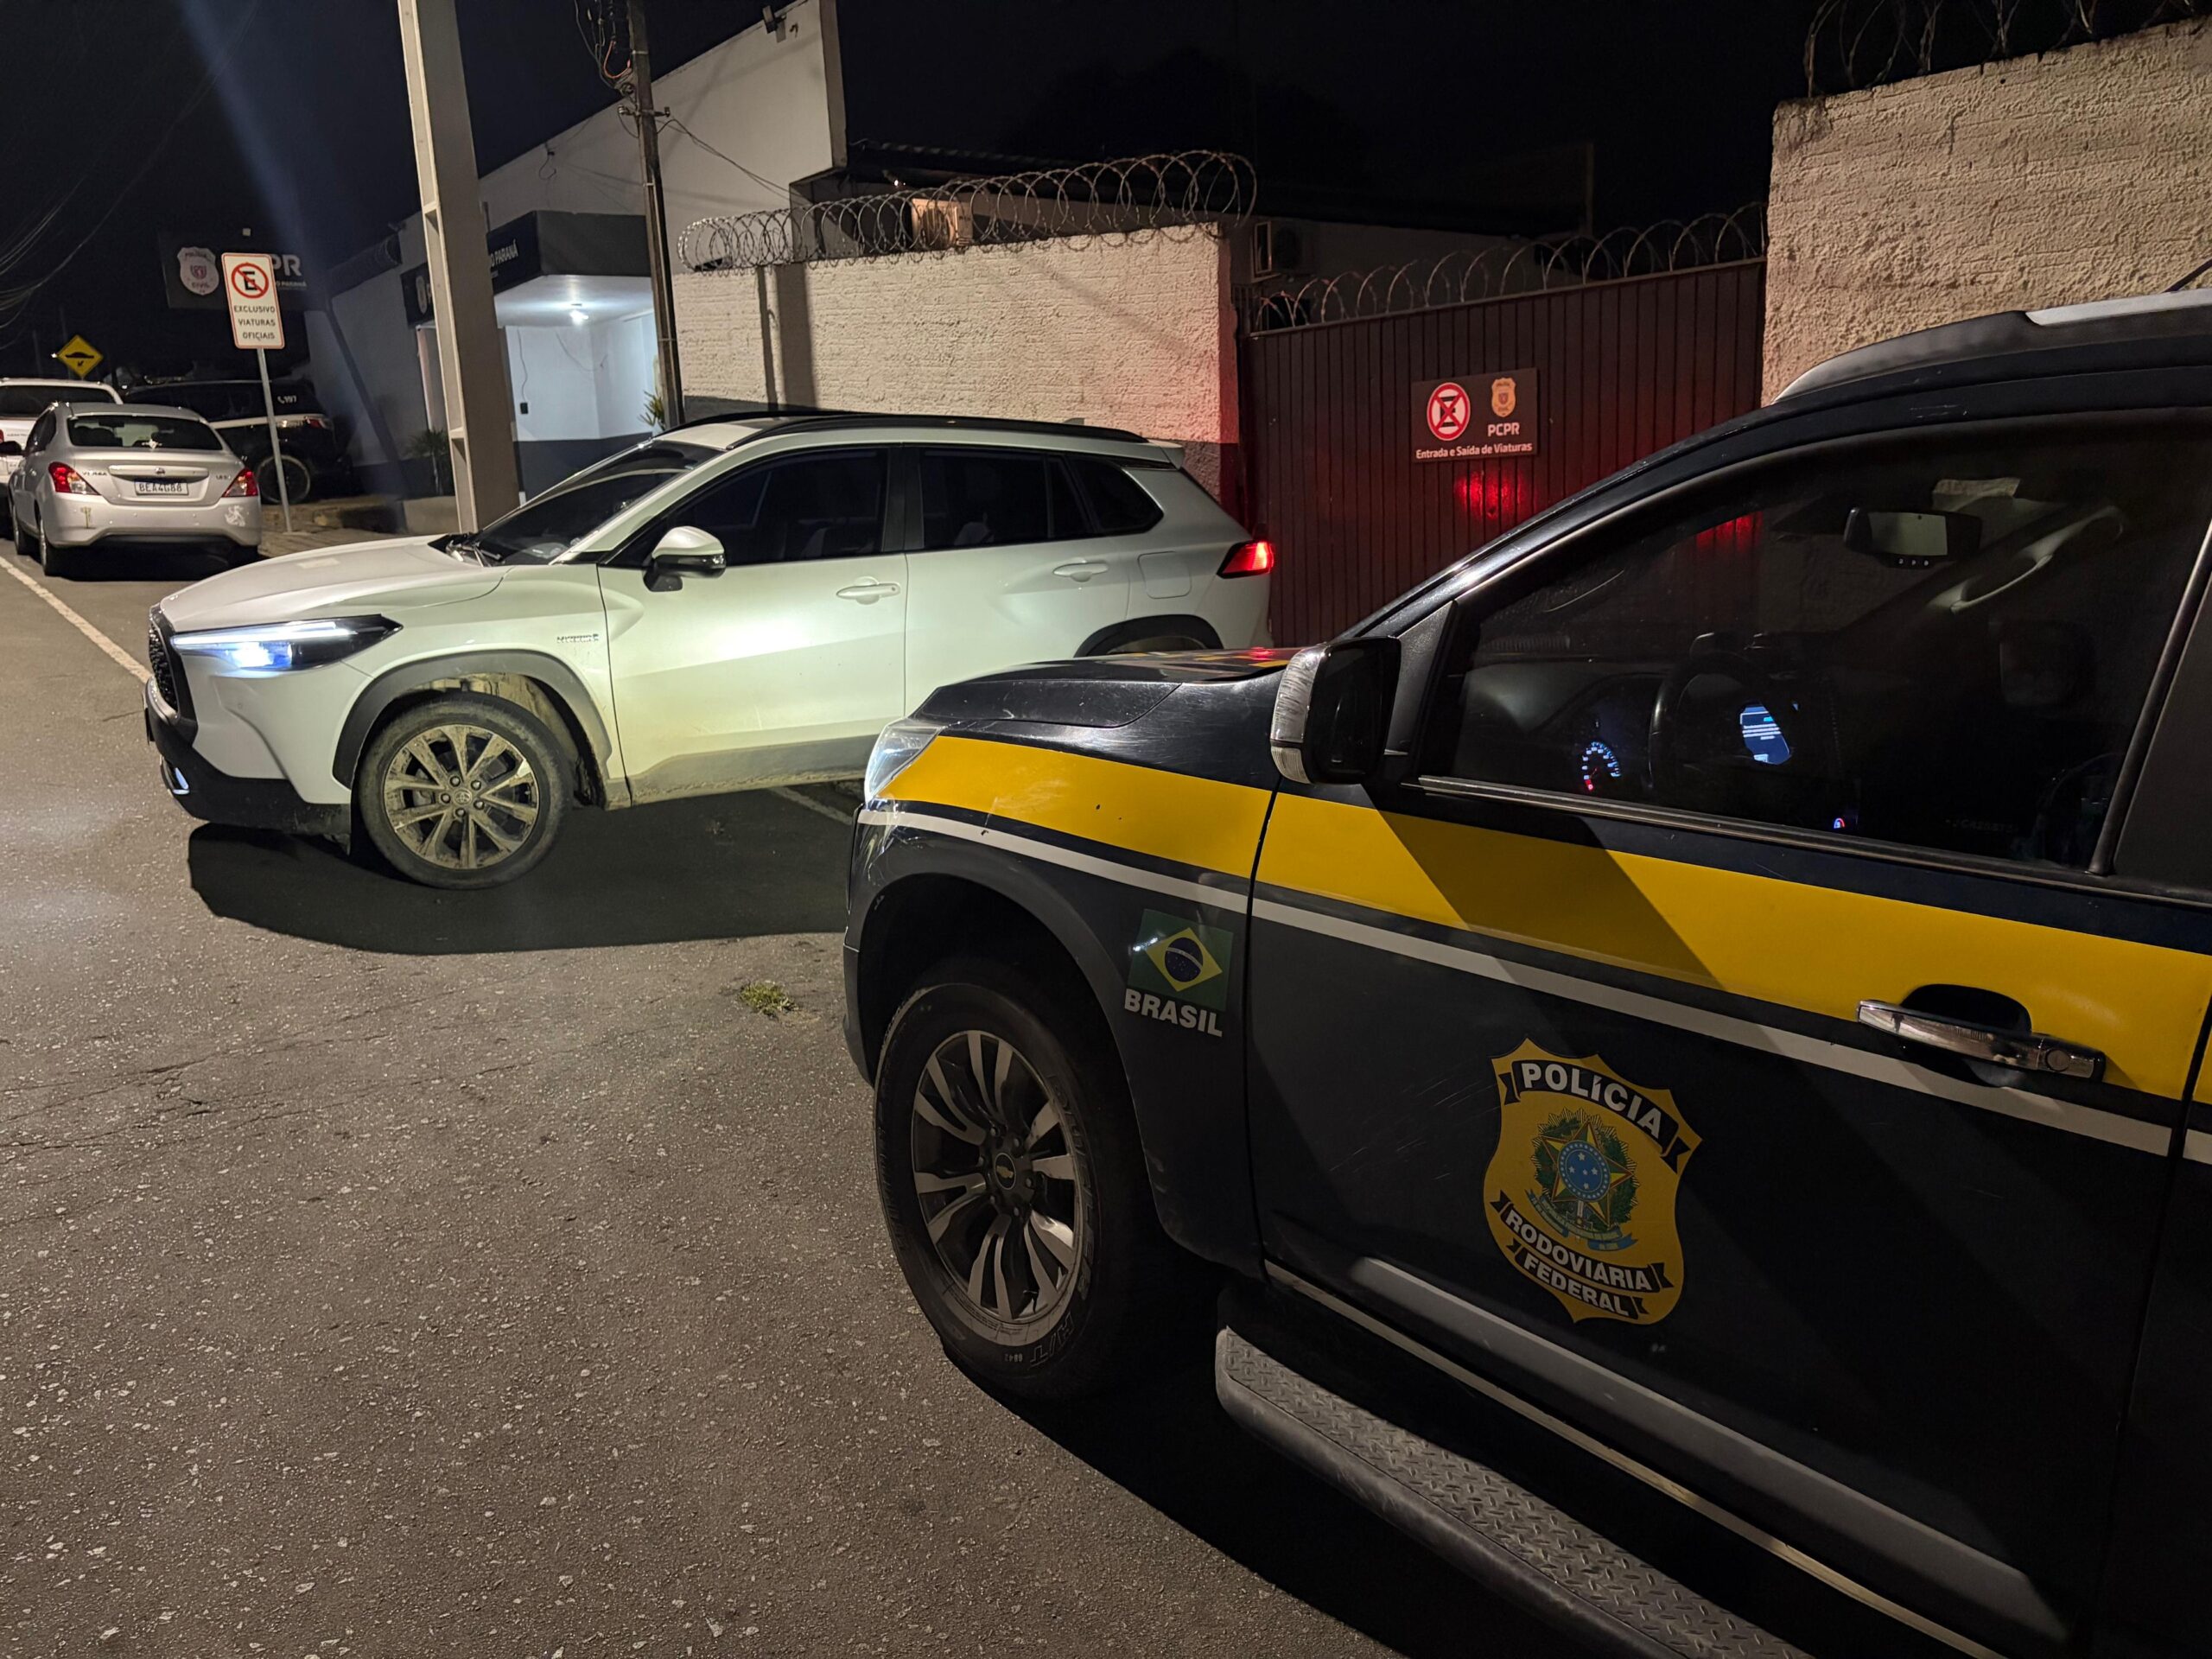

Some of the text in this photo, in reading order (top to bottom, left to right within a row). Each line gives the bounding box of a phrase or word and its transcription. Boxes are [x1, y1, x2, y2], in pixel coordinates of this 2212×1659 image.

[1415, 442, 1533, 460] Entrada e Saída de Viaturas
[1487, 422, 1521, 437] PCPR
[1124, 988, 1224, 1038] BRASIL
[1520, 1062, 1664, 1140] POLÍCIA
[1505, 1205, 1652, 1291] RODOVIÁRIA
[1522, 1252, 1630, 1317] FEDERAL
